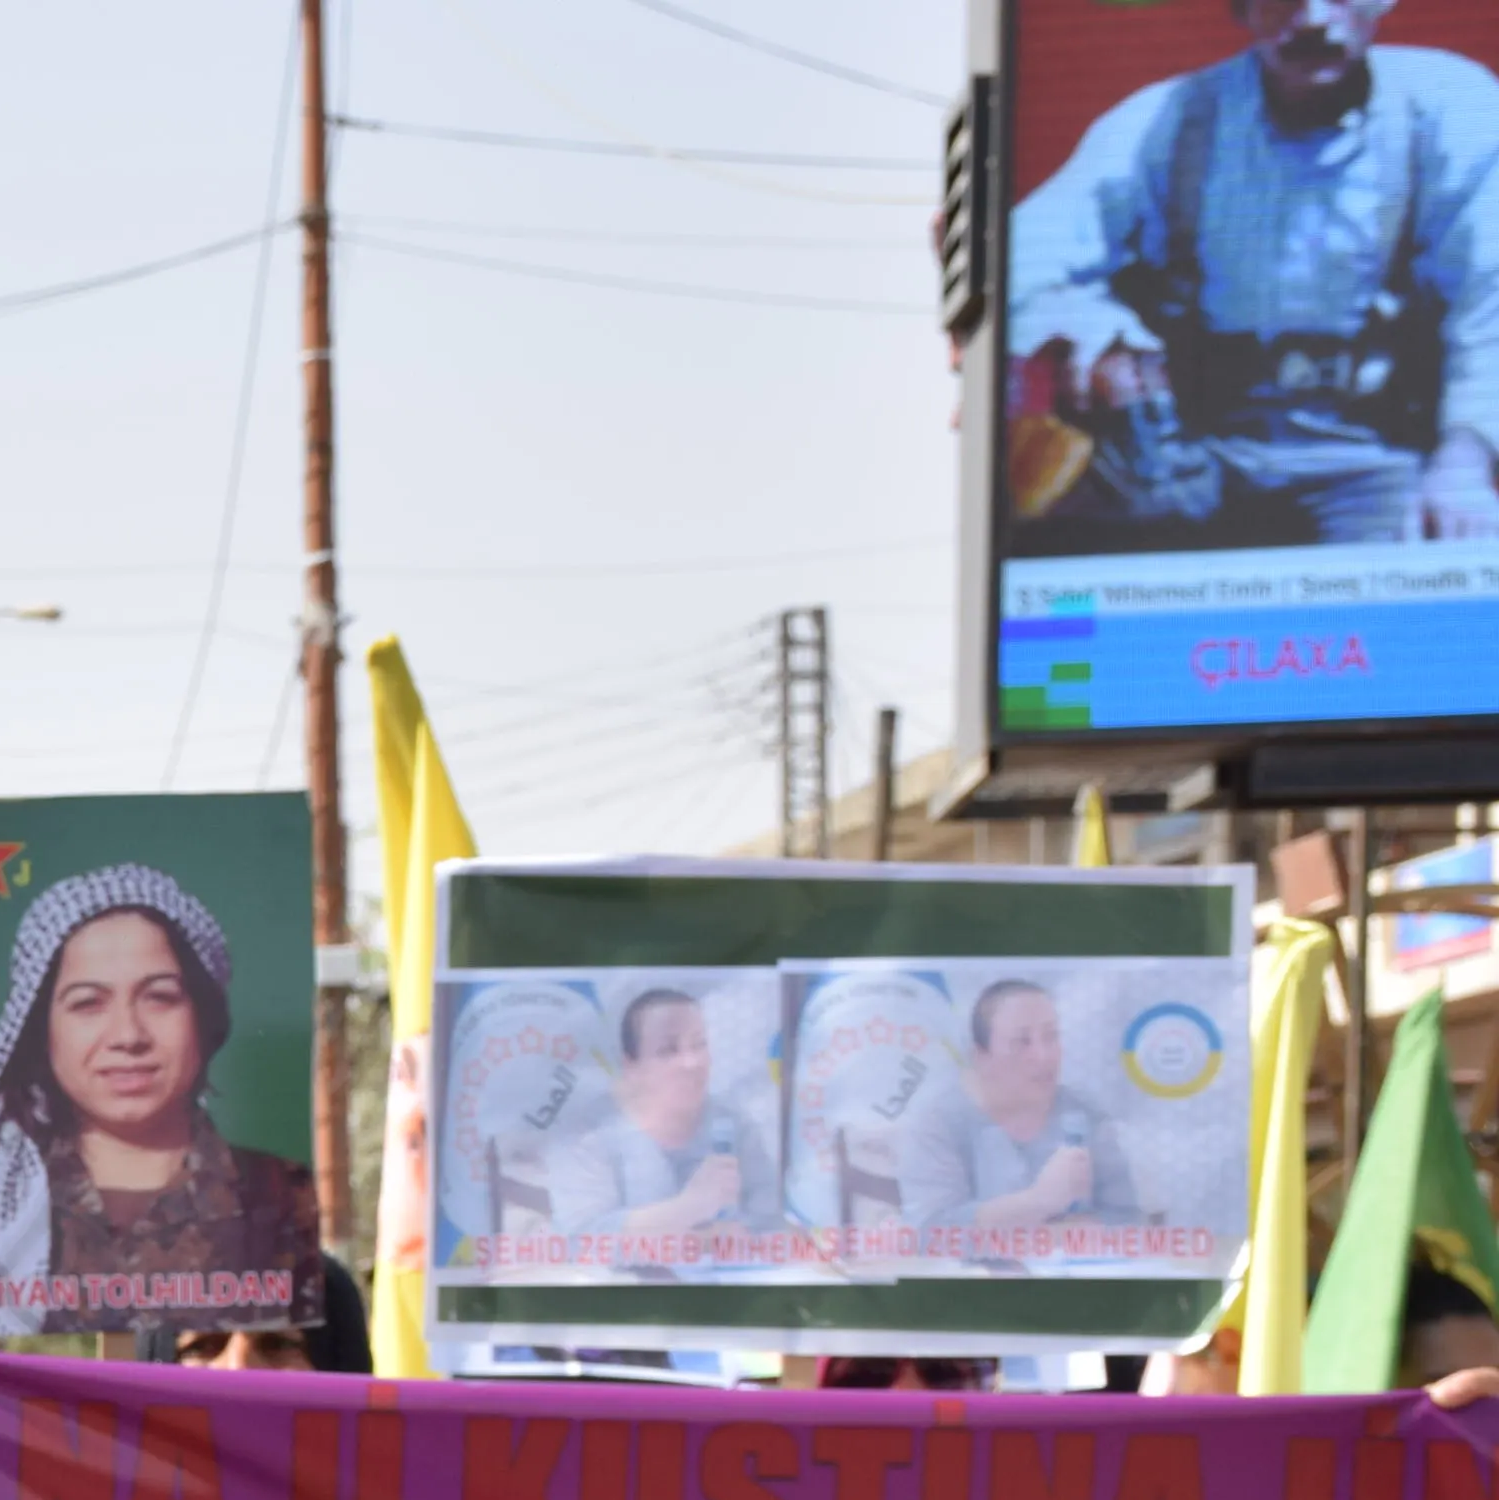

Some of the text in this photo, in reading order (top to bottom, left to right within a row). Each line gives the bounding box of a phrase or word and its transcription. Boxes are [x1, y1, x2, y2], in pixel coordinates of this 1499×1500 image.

[12, 859, 32, 887] J
[577, 1233, 700, 1265] ZEYNEB
[926, 1224, 1052, 1259] ZEYNEB
[1064, 1223, 1214, 1260] MIHEMED
[84, 1271, 293, 1309] TOLHILDAN
